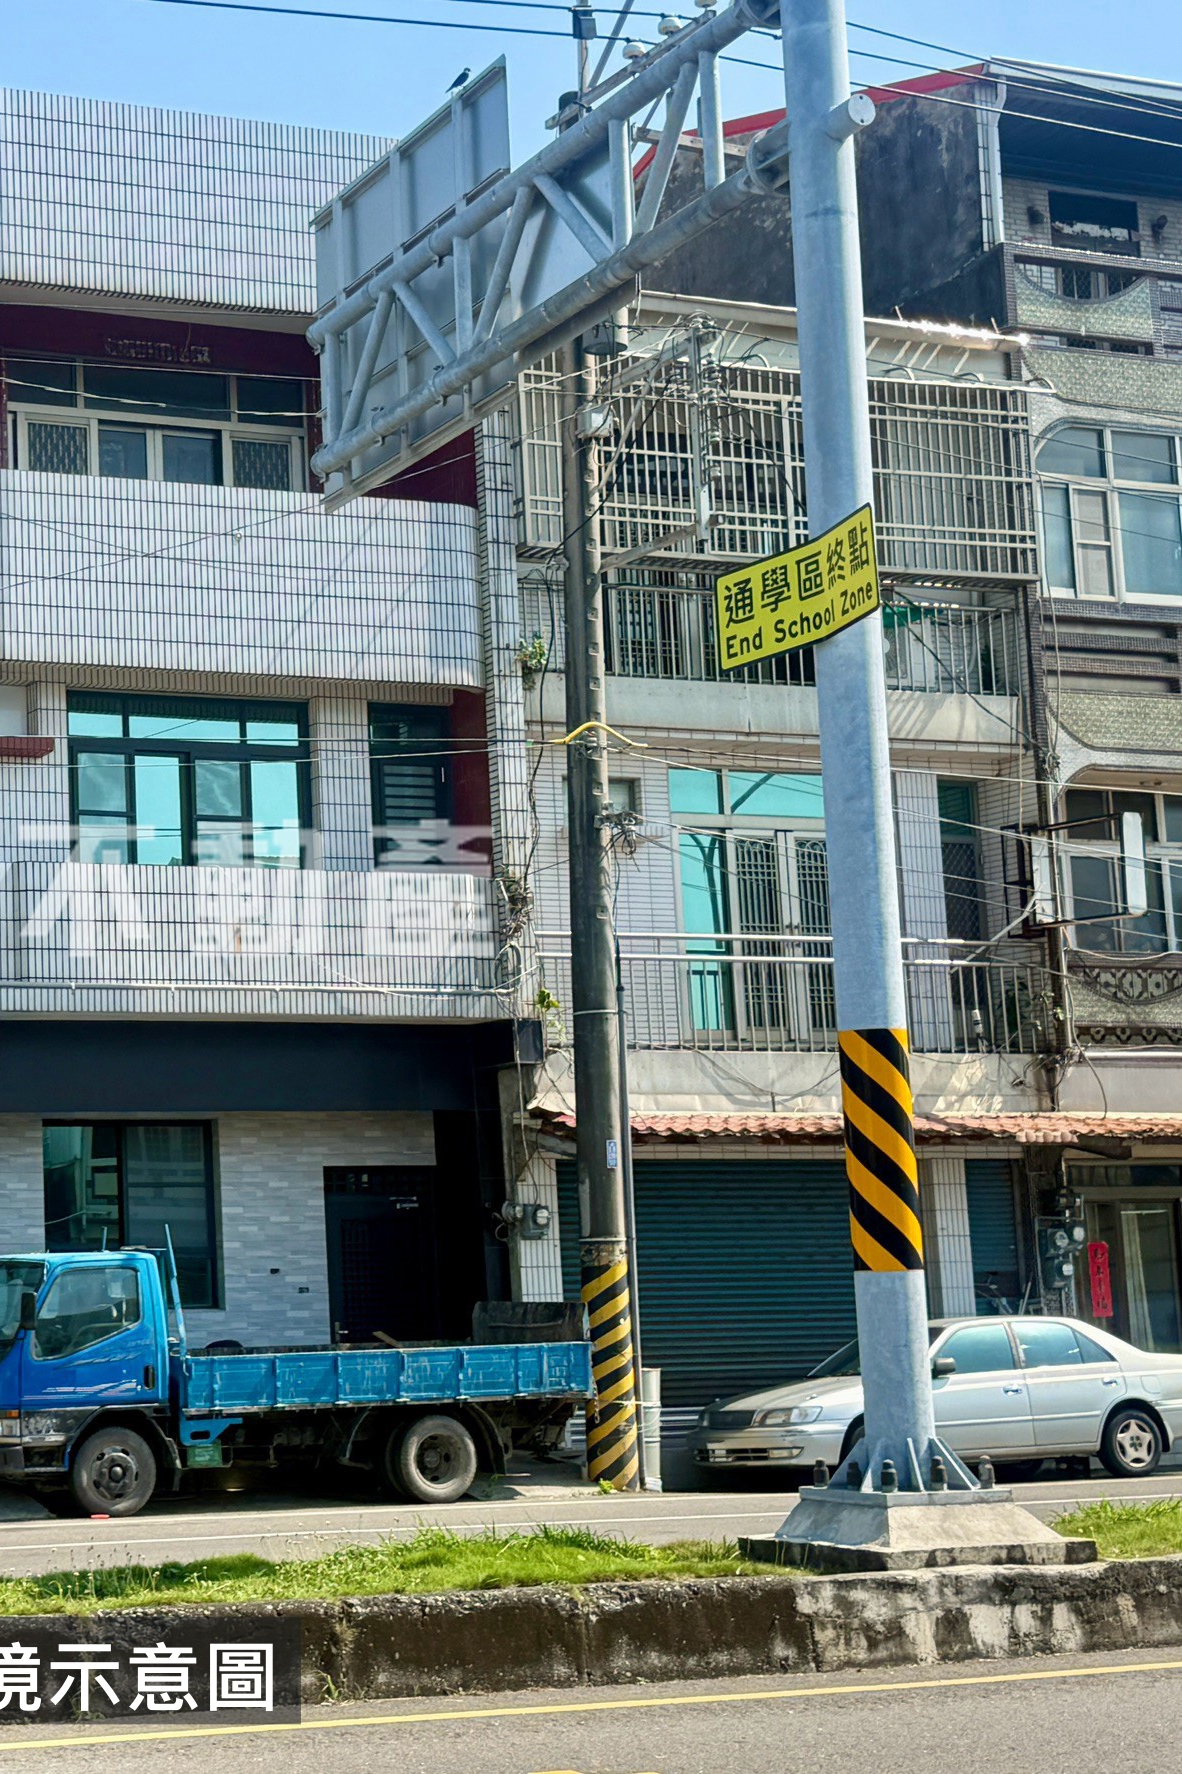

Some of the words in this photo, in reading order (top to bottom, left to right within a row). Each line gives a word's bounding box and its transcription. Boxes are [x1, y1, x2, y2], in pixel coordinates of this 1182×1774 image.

[723, 521, 870, 629] 通學區終點
[726, 626, 763, 659] End
[774, 599, 836, 643] School
[840, 581, 873, 617] Zone
